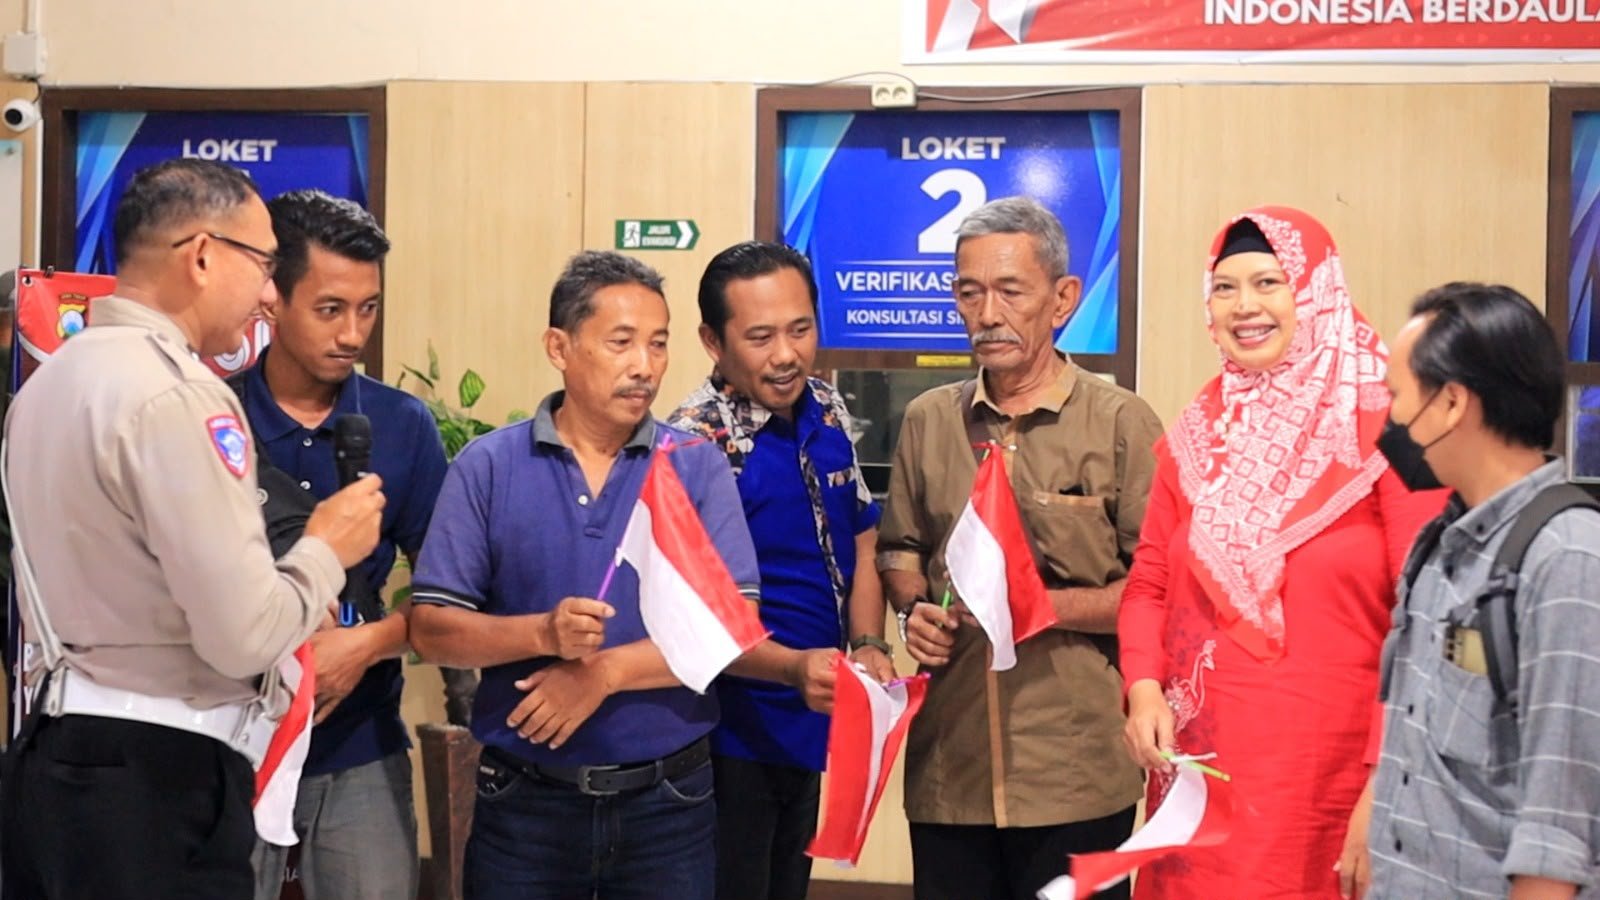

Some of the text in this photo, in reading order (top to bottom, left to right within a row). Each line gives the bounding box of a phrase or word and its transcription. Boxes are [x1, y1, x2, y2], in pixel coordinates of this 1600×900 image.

[1203, 0, 1600, 25] INDONESIA BERDAUL
[182, 139, 278, 162] LOKET
[901, 136, 1006, 161] LOKET
[918, 168, 987, 253] 2
[846, 310, 943, 325] KONSULTASI
